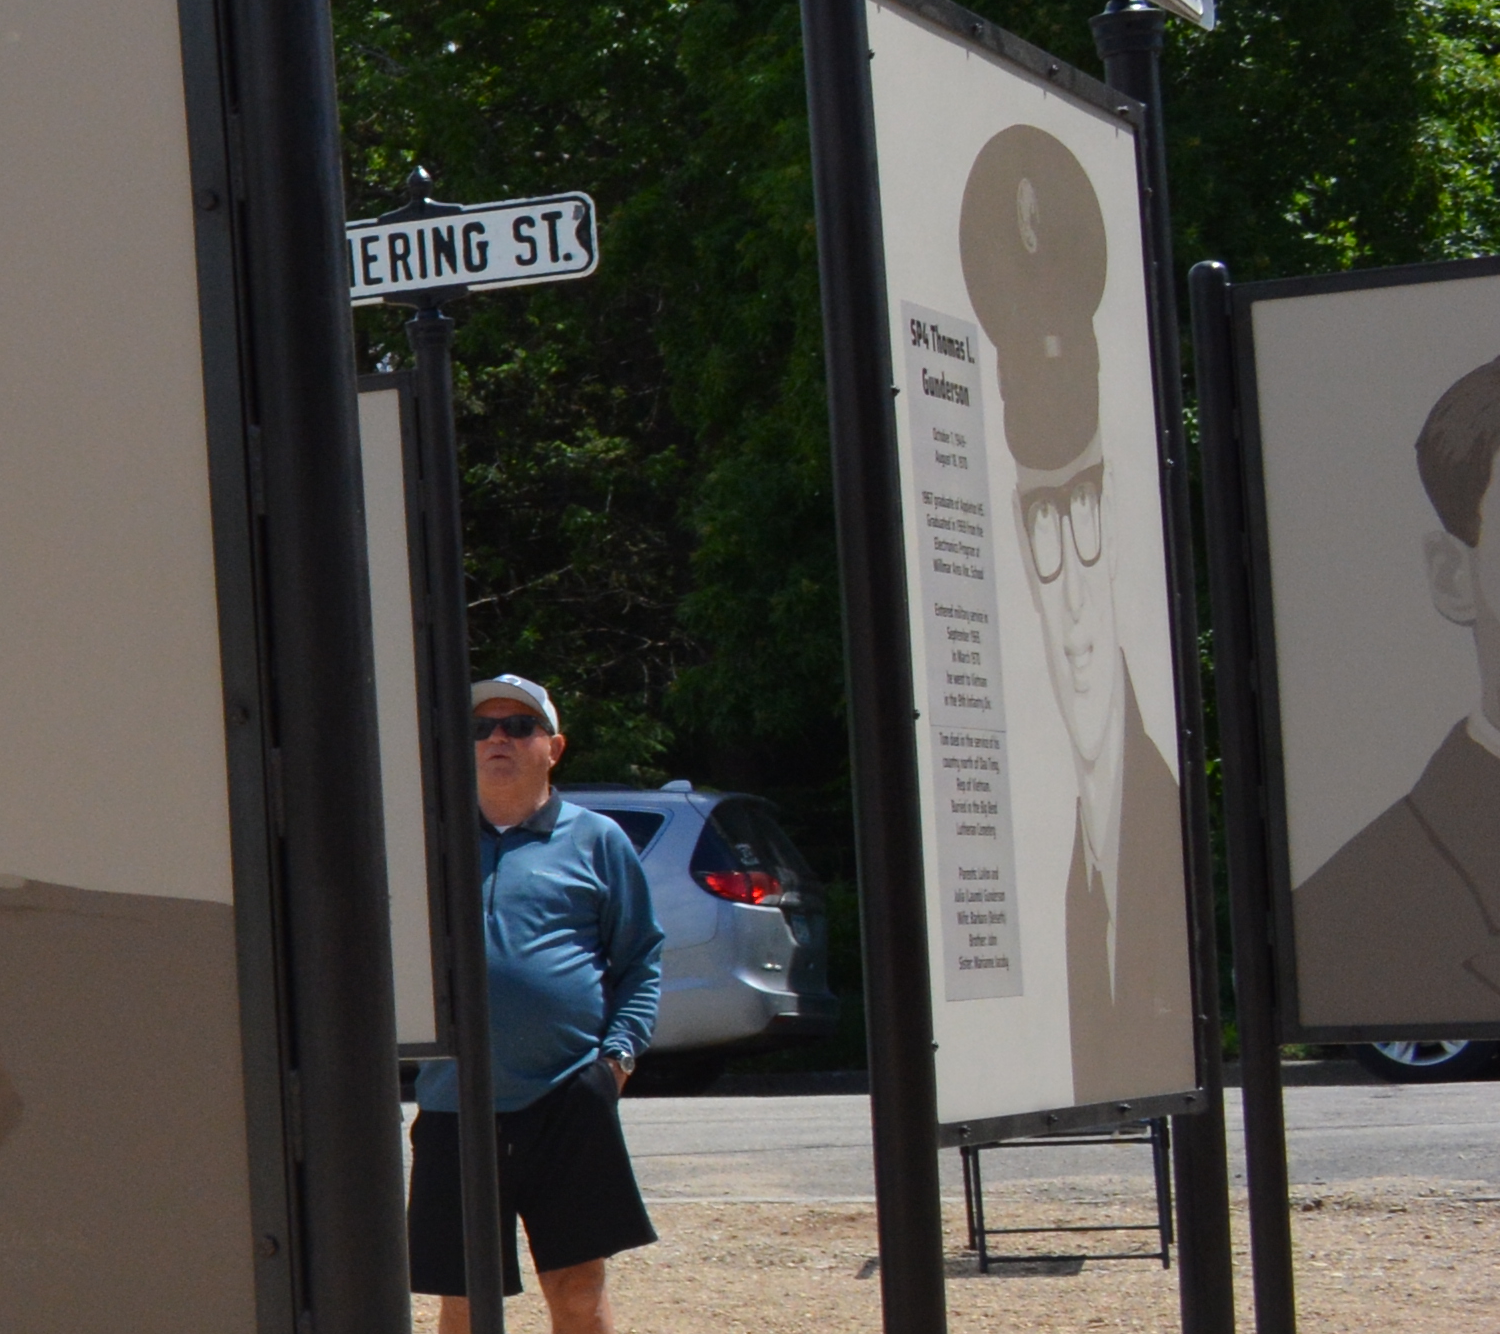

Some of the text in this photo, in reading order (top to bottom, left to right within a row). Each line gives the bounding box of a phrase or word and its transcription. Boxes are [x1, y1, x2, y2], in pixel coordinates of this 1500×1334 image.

[348, 210, 573, 288] ERING ST.
[910, 318, 975, 364] SP4 Thomas L.
[921, 367, 970, 407] Gunderson
